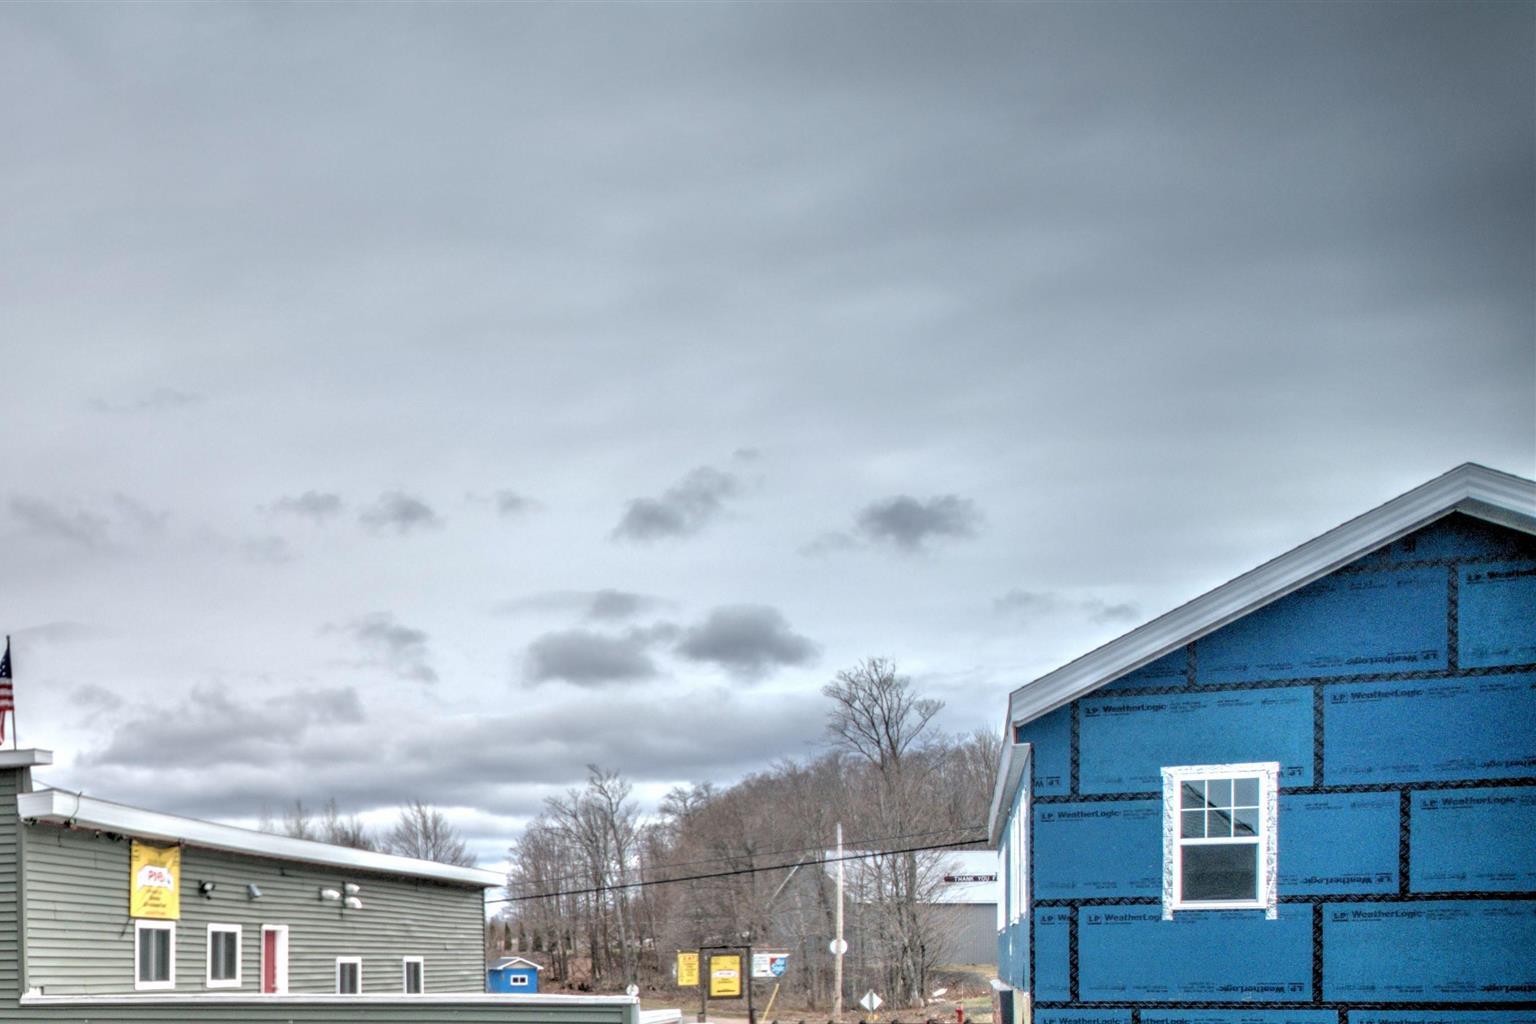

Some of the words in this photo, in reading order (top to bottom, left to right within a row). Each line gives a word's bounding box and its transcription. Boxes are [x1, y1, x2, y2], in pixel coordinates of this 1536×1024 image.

[1350, 688, 1424, 699] WeatherLogic
[1102, 703, 1167, 713] WeatherLogic
[1441, 796, 1518, 807] WeatherLogic
[1057, 810, 1121, 819] WeatherLogic
[1303, 875, 1373, 886] WeatherLogic
[1351, 910, 1425, 920] WeatherLogic
[1216, 983, 1285, 994] WeatherLogic
